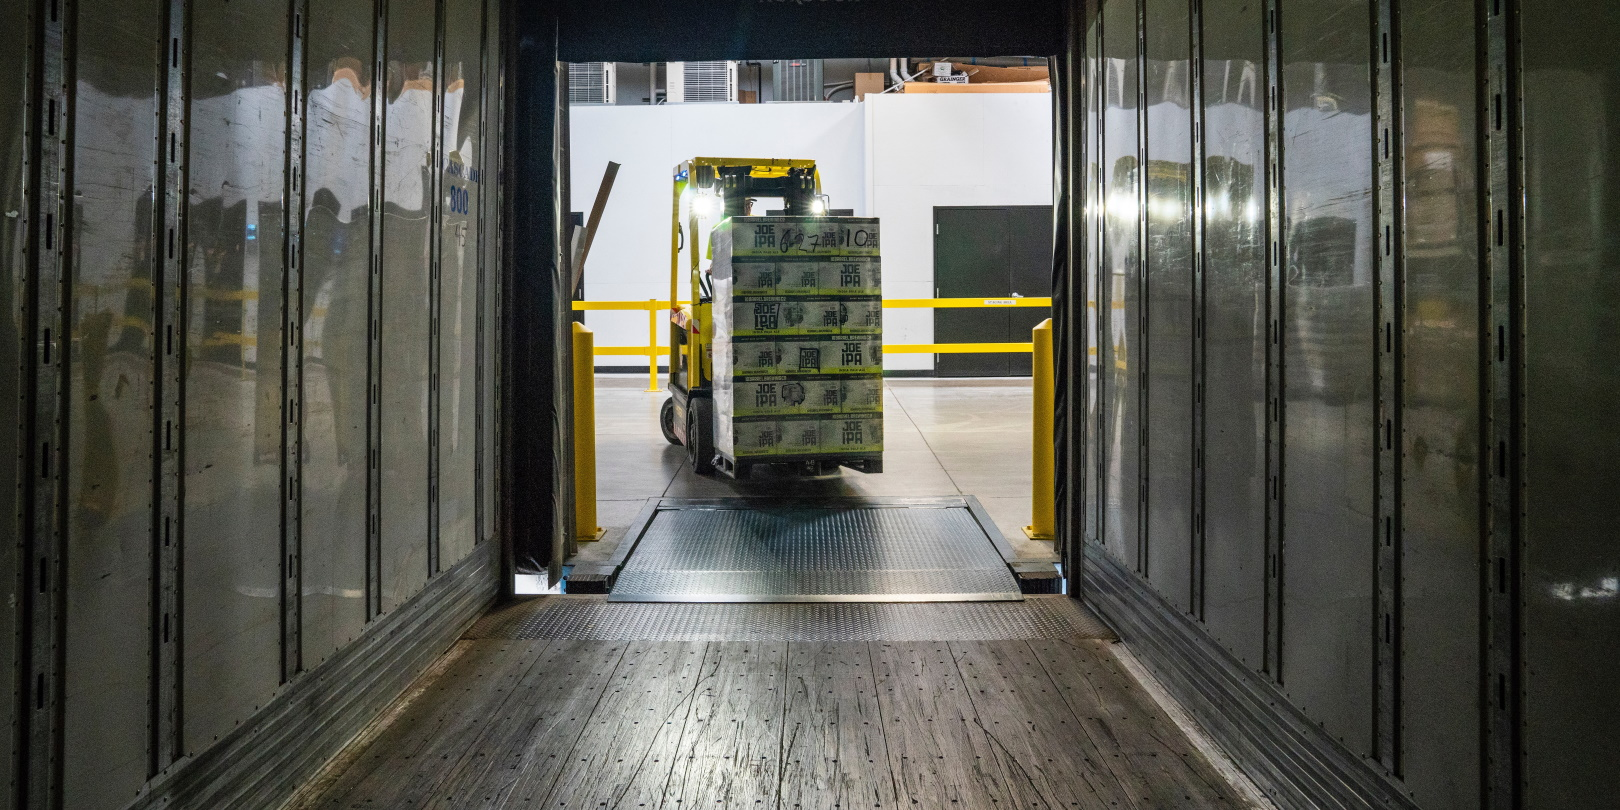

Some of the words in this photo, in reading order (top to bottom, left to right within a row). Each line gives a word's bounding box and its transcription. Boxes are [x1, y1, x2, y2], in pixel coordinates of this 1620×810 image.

[450, 185, 468, 215] 800
[754, 225, 774, 234] JOE
[754, 235, 775, 247] IPA
[847, 229, 868, 247] 10
[841, 264, 860, 274] JOE
[840, 275, 860, 287] IPA
[756, 304, 776, 314] JOE
[755, 315, 776, 328] IPA
[823, 318, 838, 326] IPA
[866, 318, 879, 326] IPA
[842, 343, 861, 352] JOE
[758, 359, 772, 367] IPA
[801, 358, 816, 367] IPA
[842, 353, 862, 365] IPA
[756, 384, 776, 393] JOE
[756, 394, 776, 407] IPA
[824, 397, 838, 405] IPA
[866, 396, 880, 404] IPA
[843, 421, 862, 431] JOE
[802, 438, 816, 446] IPA
[842, 432, 862, 444] IPA
[759, 439, 773, 447] IPA
